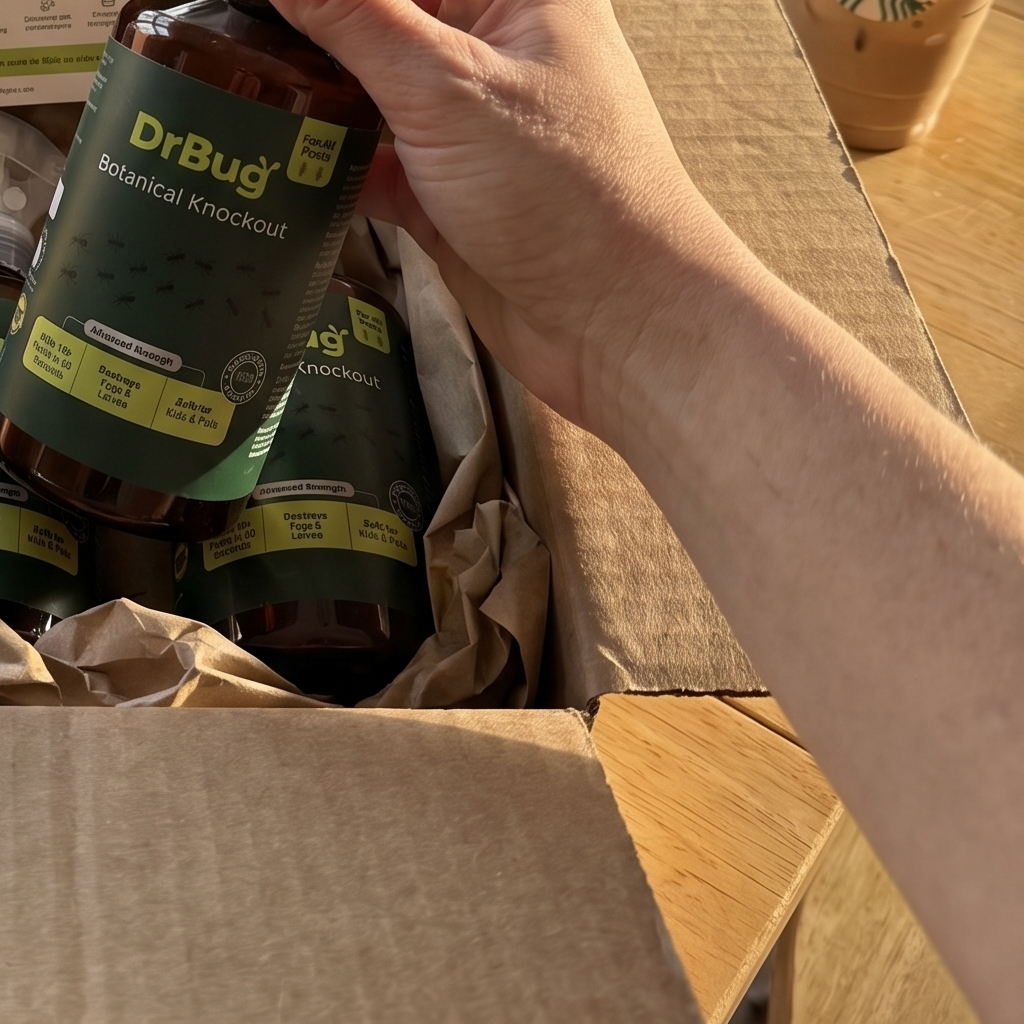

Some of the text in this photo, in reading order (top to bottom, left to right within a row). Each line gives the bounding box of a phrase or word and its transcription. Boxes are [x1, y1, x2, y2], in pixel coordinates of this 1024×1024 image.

[98, 153, 288, 240] Botanical Knockout
[129, 110, 281, 200] DrBug
